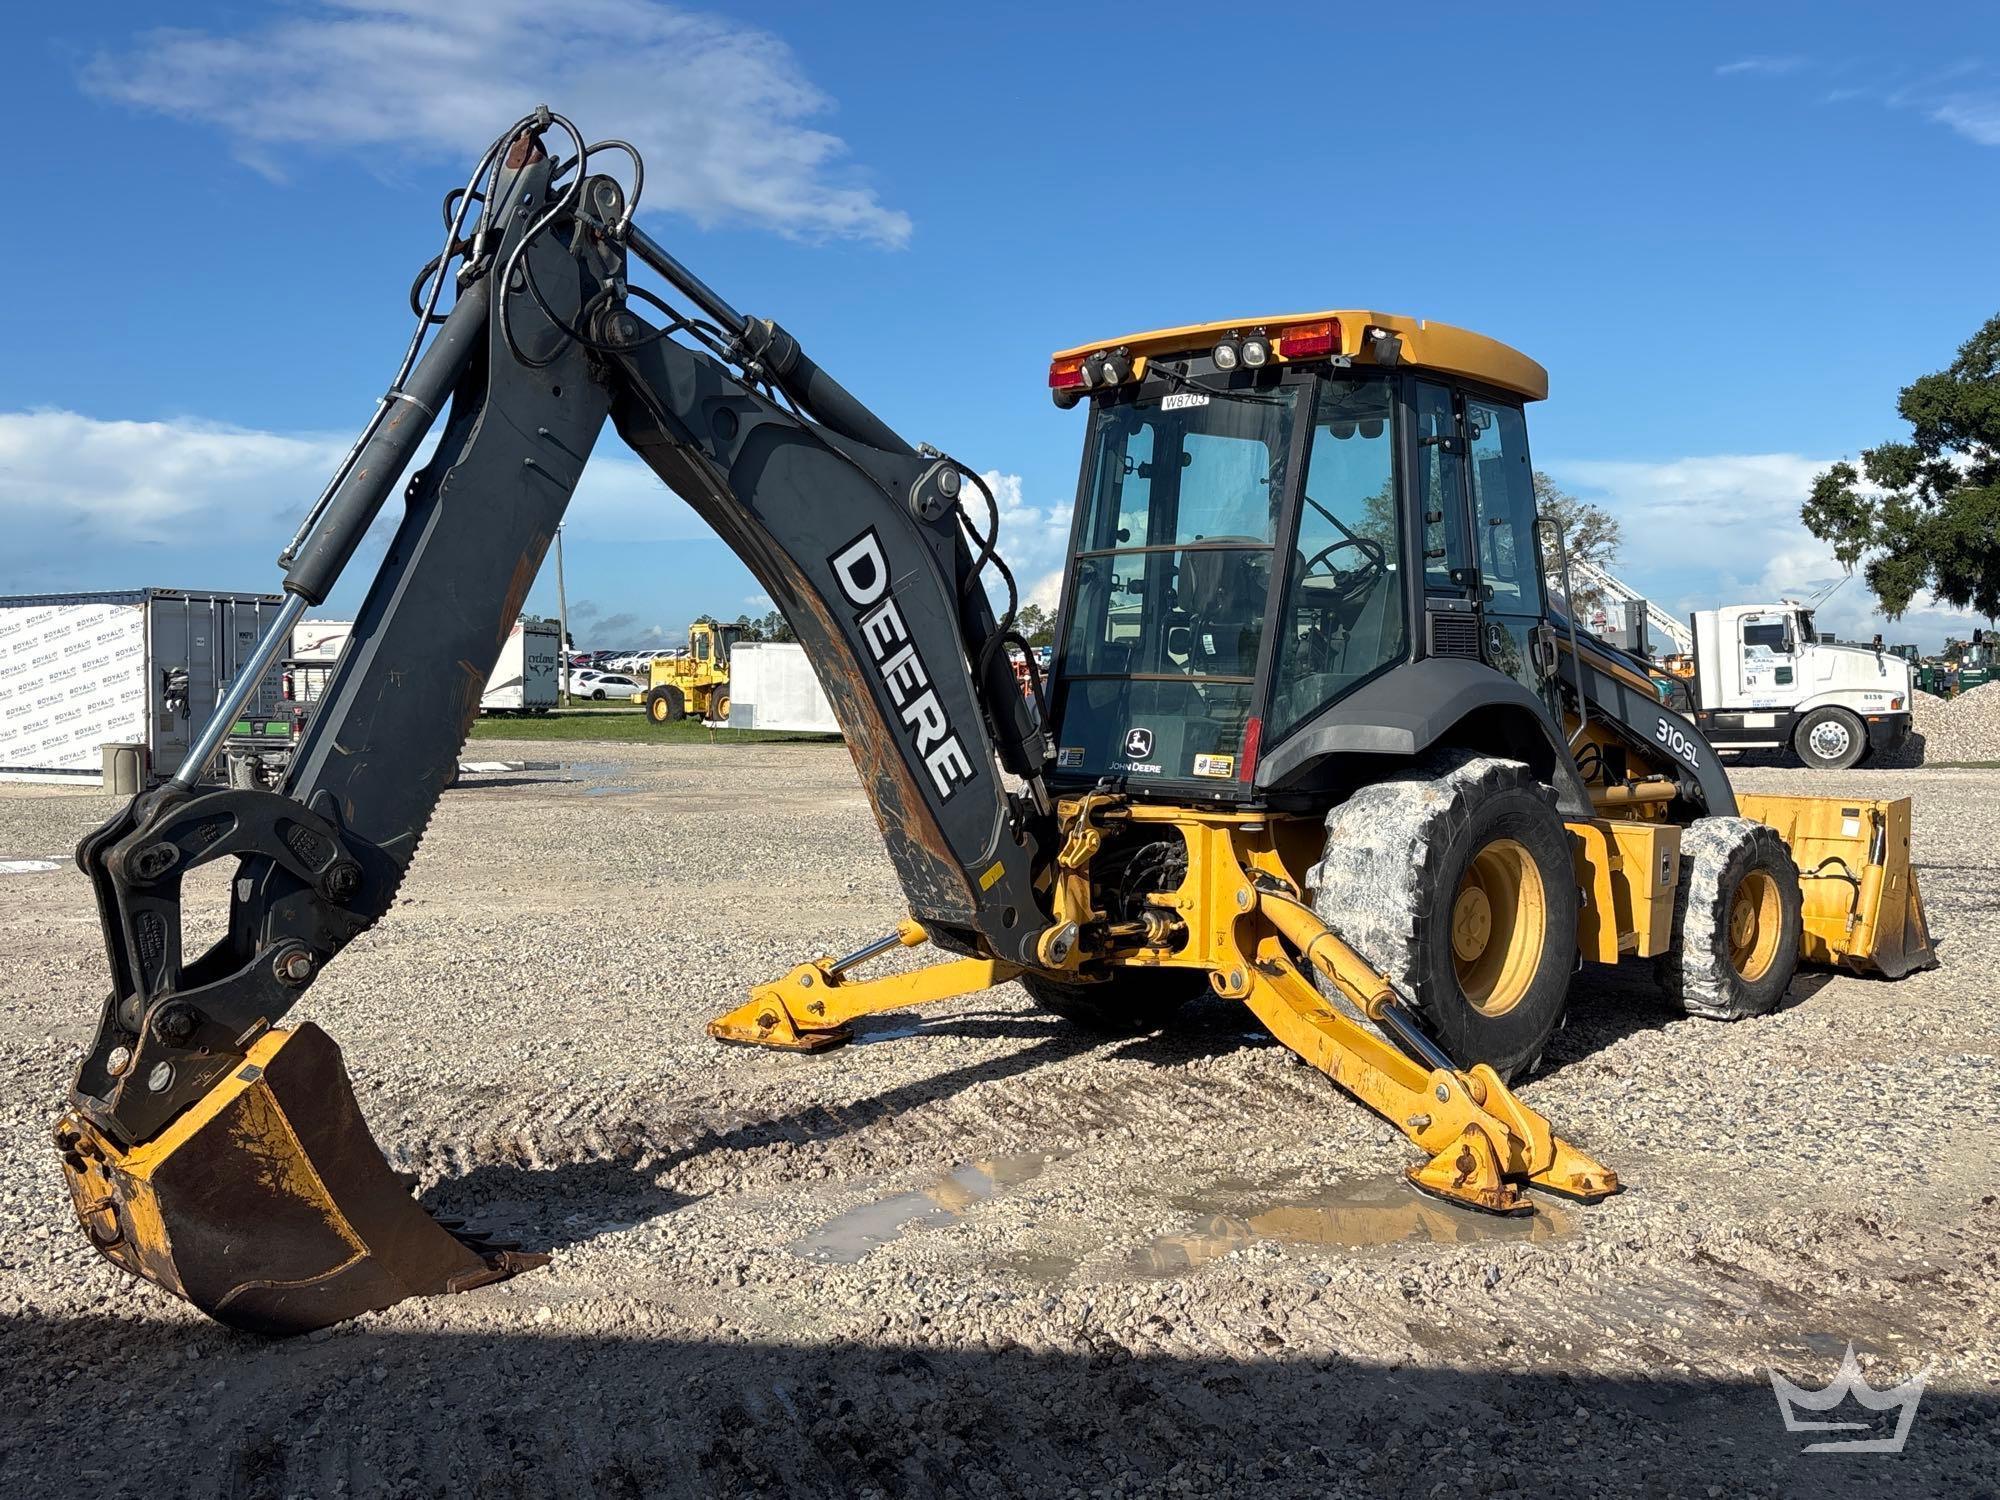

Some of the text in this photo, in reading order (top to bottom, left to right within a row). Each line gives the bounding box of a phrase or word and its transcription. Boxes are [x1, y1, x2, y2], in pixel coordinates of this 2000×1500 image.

[97, 630, 118, 641] ROYAL
[115, 645, 137, 657] ROYAL
[833, 533, 972, 798] DEERE
[1656, 718, 1699, 768] 310SL
[1109, 762, 1162, 773] JOHN DEERE
